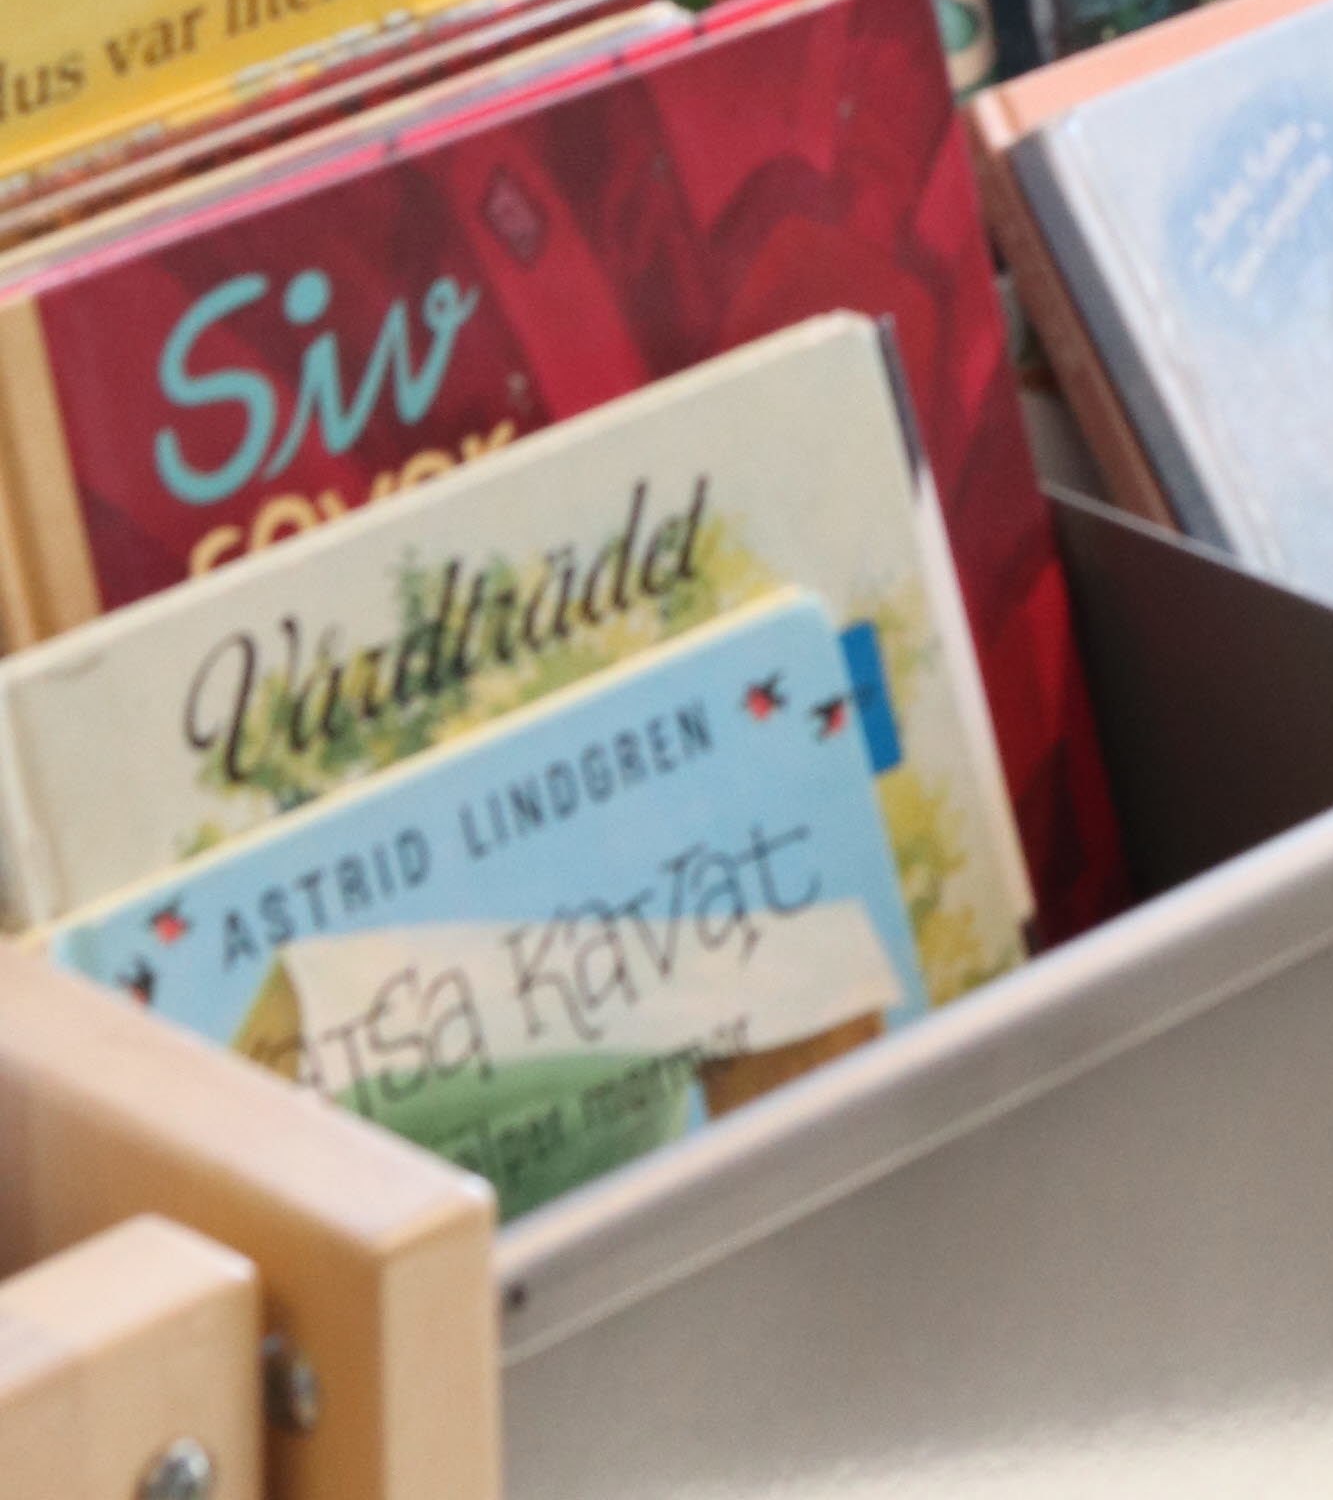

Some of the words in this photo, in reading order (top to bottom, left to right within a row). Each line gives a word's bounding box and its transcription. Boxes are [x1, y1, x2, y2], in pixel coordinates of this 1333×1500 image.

[105, 5, 206, 77] var
[155, 268, 481, 507] Siv
[221, 826, 434, 973] ASTRID
[456, 701, 715, 861] LINDGREN
